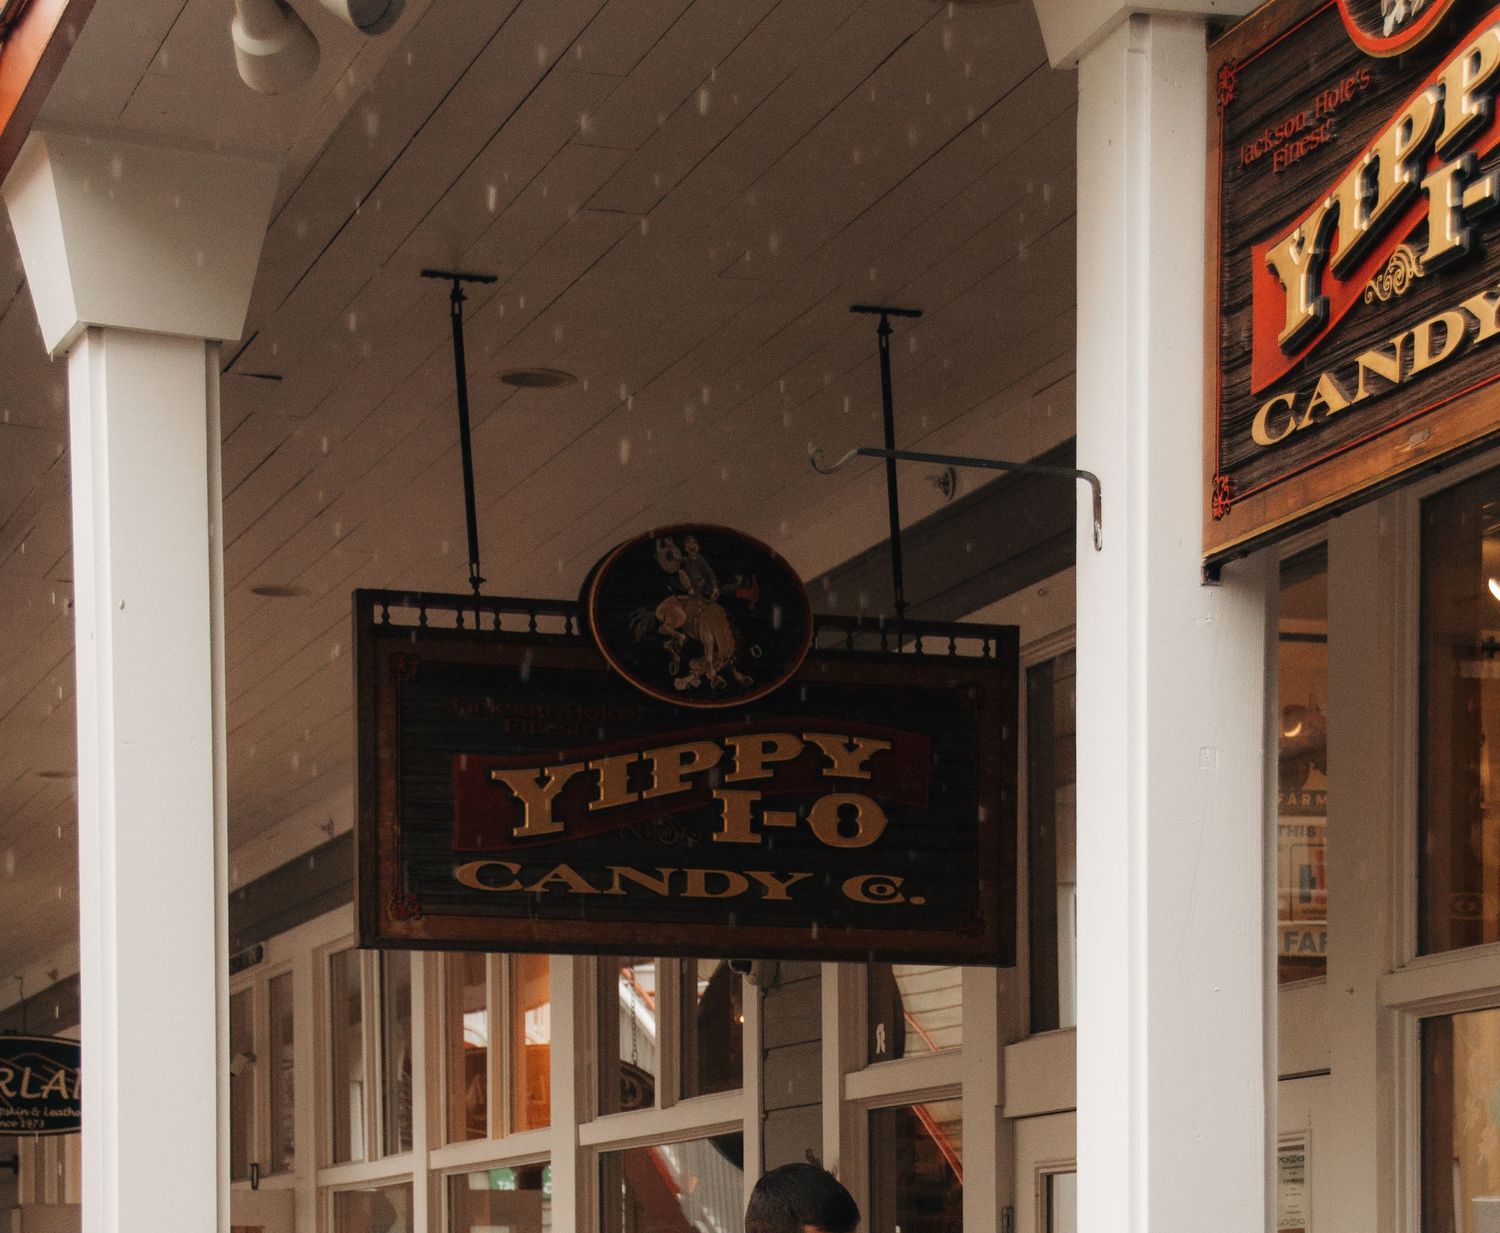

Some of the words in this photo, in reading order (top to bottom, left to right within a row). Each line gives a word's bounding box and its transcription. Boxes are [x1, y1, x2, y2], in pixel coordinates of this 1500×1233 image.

[1236, 111, 1307, 171] Jackson
[1315, 66, 1371, 118] Hole's
[491, 732, 892, 837] YIPPY
[712, 788, 889, 849] I-O
[454, 859, 814, 901] CANDY
